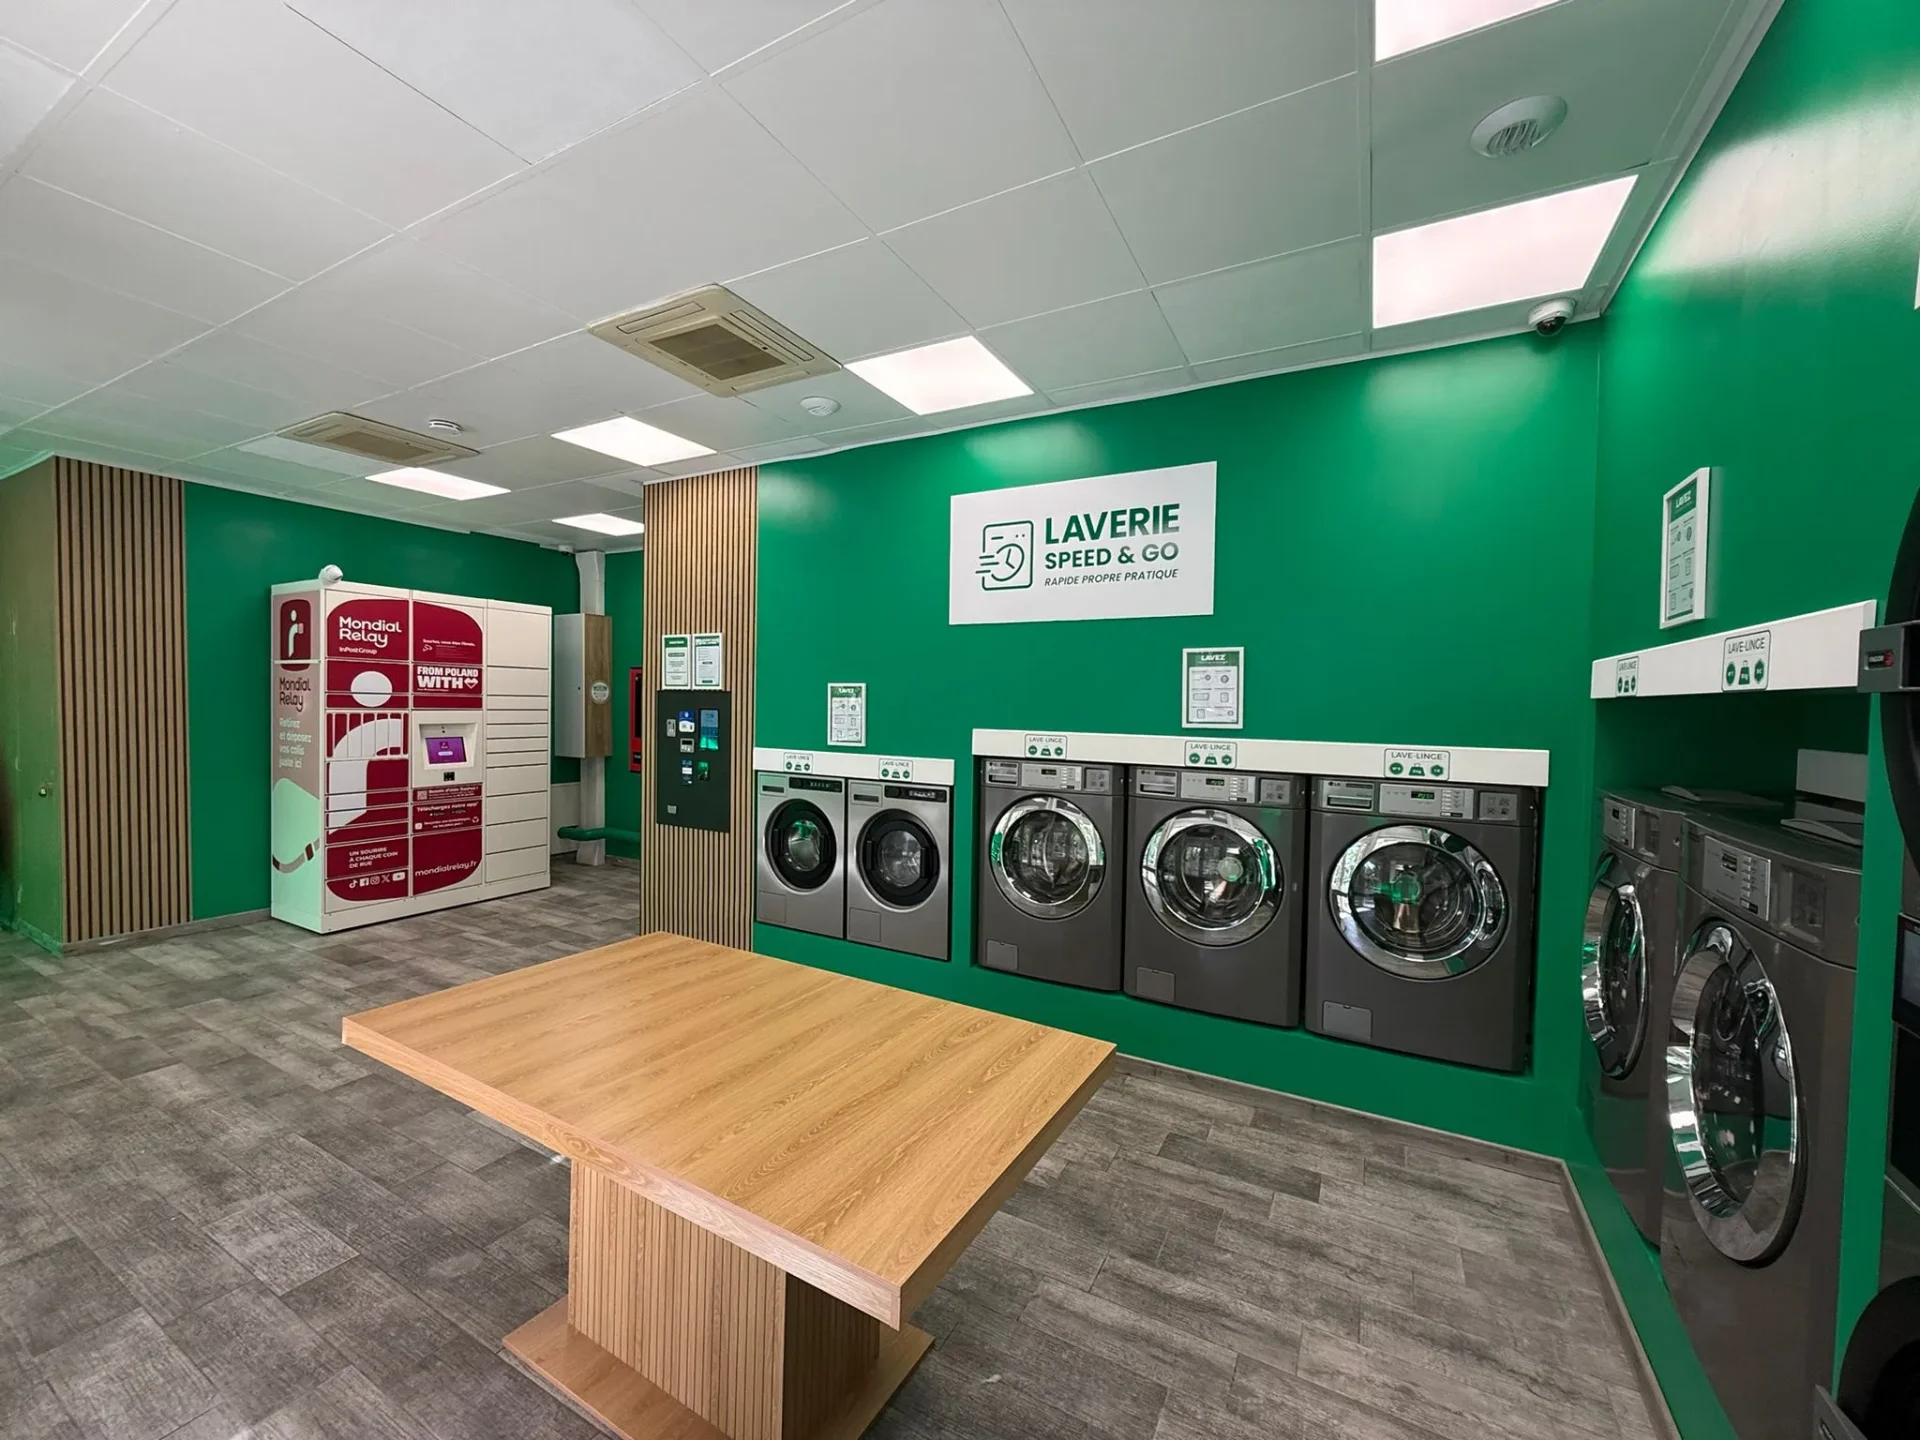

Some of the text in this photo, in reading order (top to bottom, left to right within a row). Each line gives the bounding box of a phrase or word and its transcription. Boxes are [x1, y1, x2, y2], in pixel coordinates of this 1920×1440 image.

[1045, 503, 1180, 545] LAVERIE
[1045, 541, 1179, 570] SPEED & GO
[1044, 568, 1179, 587] RAPIDE PROPRE PRATIQUE
[339, 616, 402, 633] Mondial
[339, 629, 388, 648] Relay
[1728, 637, 1765, 654] LAVE-LINGE
[417, 666, 478, 677] FROM POLAND
[280, 678, 311, 691] Mondial
[417, 675, 463, 689] WITH
[279, 691, 304, 713] Relay
[1391, 752, 1443, 760] LAVE-LINGE
[355, 853, 382, 861] CHAQUE
[360, 847, 387, 856] SOURIRE
[415, 860, 478, 877] mondialrelay.fr
